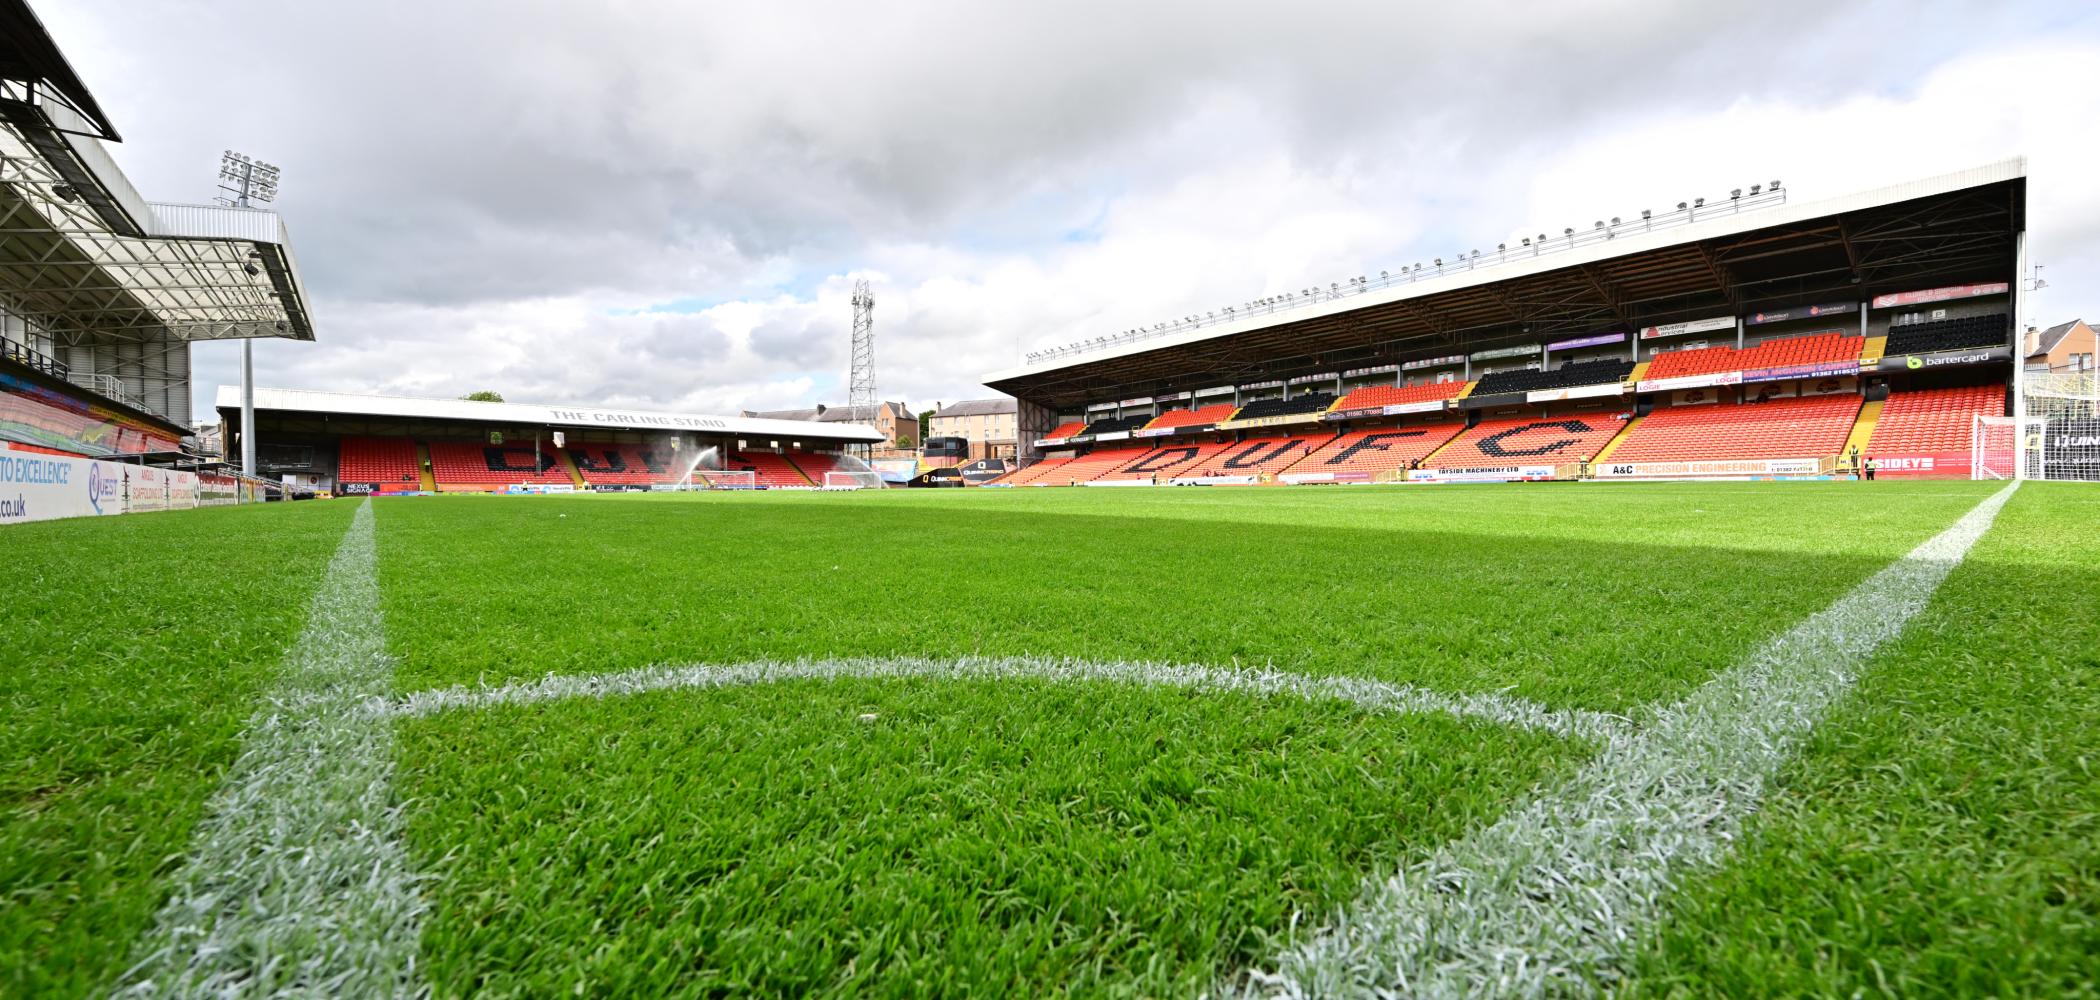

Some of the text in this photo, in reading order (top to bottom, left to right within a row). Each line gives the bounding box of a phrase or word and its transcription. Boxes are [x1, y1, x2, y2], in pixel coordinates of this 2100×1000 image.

[1934, 286, 1964, 295] SIMPSON
[1926, 352, 1989, 366] bartercard
[1743, 361, 1859, 378] KEVIN McGUCKIN CARPETS
[1715, 376, 1739, 384] LOGIE
[1639, 383, 1660, 391] LOGIE
[1531, 390, 1559, 398] Advanta
[549, 410, 726, 428] THE CARLING STAND
[0, 456, 14, 482] TO
[1612, 465, 1633, 475] A&C
[1635, 464, 1690, 474] PRECISION
[1692, 462, 1767, 473] ENGINEERING
[1875, 458, 1921, 468] SIDEY
[141, 469, 154, 481] ANGUS
